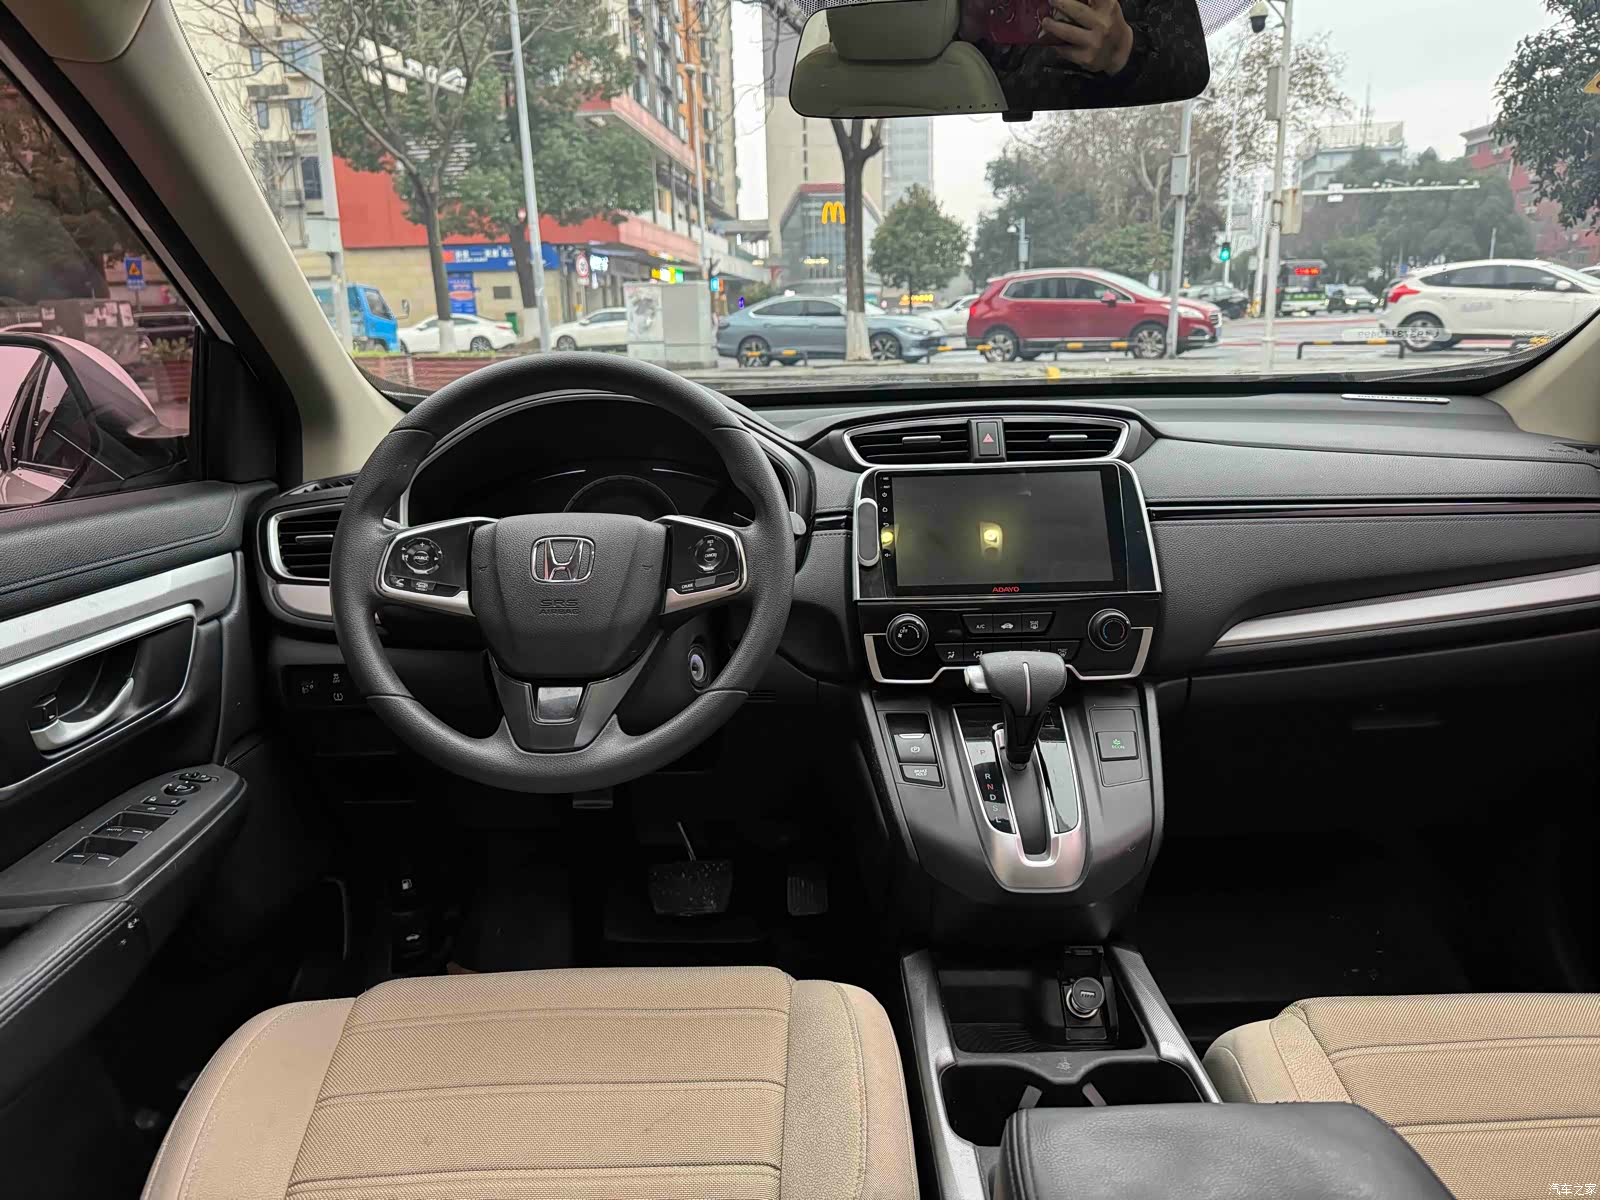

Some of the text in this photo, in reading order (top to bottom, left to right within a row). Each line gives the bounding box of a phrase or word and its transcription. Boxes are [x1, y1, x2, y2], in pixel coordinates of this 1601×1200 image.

[540, 599, 578, 608] SRS
[539, 608, 580, 616] AIRBAG
[986, 783, 994, 791] N
[989, 793, 997, 801] D
[992, 804, 999, 812] S
[995, 815, 1002, 823] L
